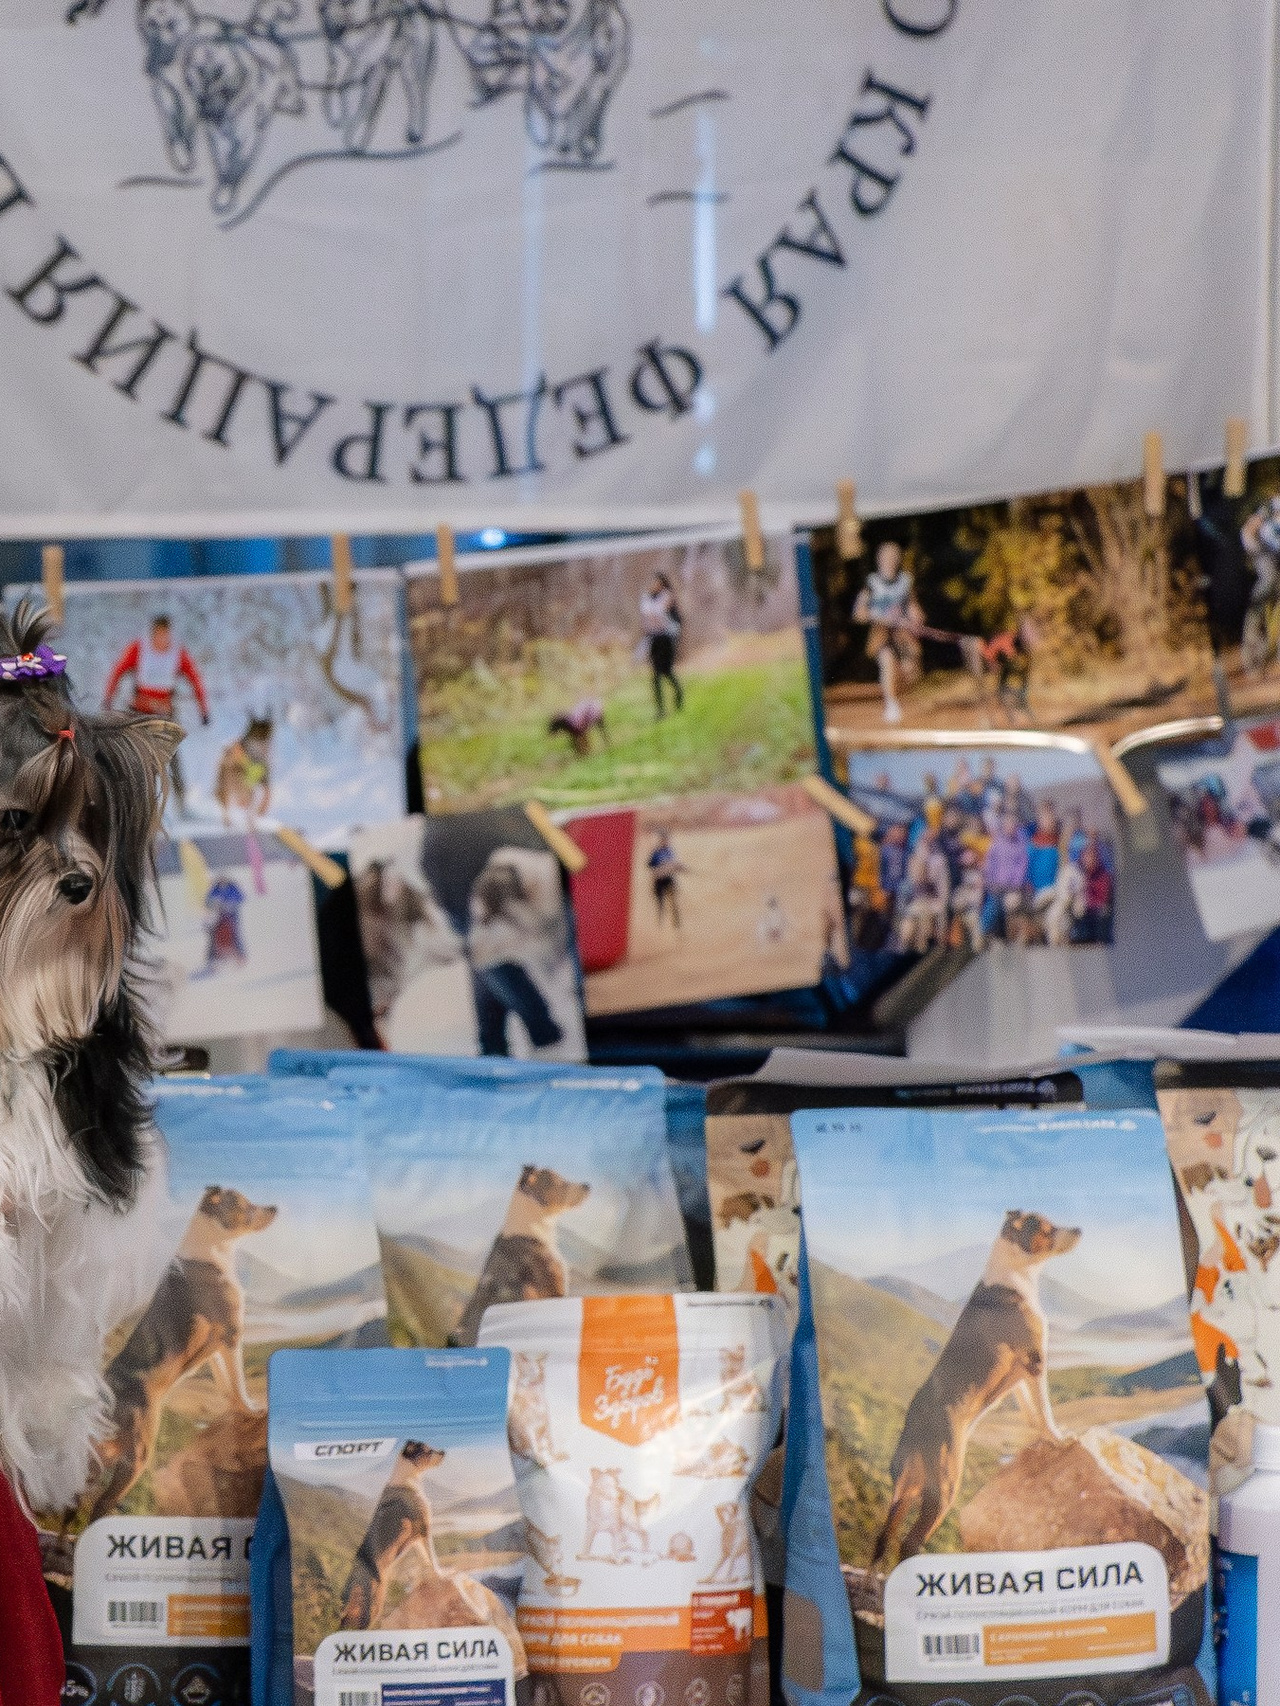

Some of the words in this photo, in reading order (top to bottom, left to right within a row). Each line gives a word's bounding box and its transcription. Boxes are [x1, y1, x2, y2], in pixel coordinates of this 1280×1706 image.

[721, 66, 933, 352] КРАЯ
[4, 236, 704, 486] ФЕДЕРАЦИЯ
[315, 1441, 383, 1456] СПОРТ
[107, 1534, 232, 1560] ЖИВАЯ
[916, 1571, 1044, 1597] ЖИВАЯ
[1057, 1561, 1144, 1590] СИЛА
[334, 1642, 428, 1662] ЖИВАЯ
[438, 1640, 499, 1659] СИЛА
